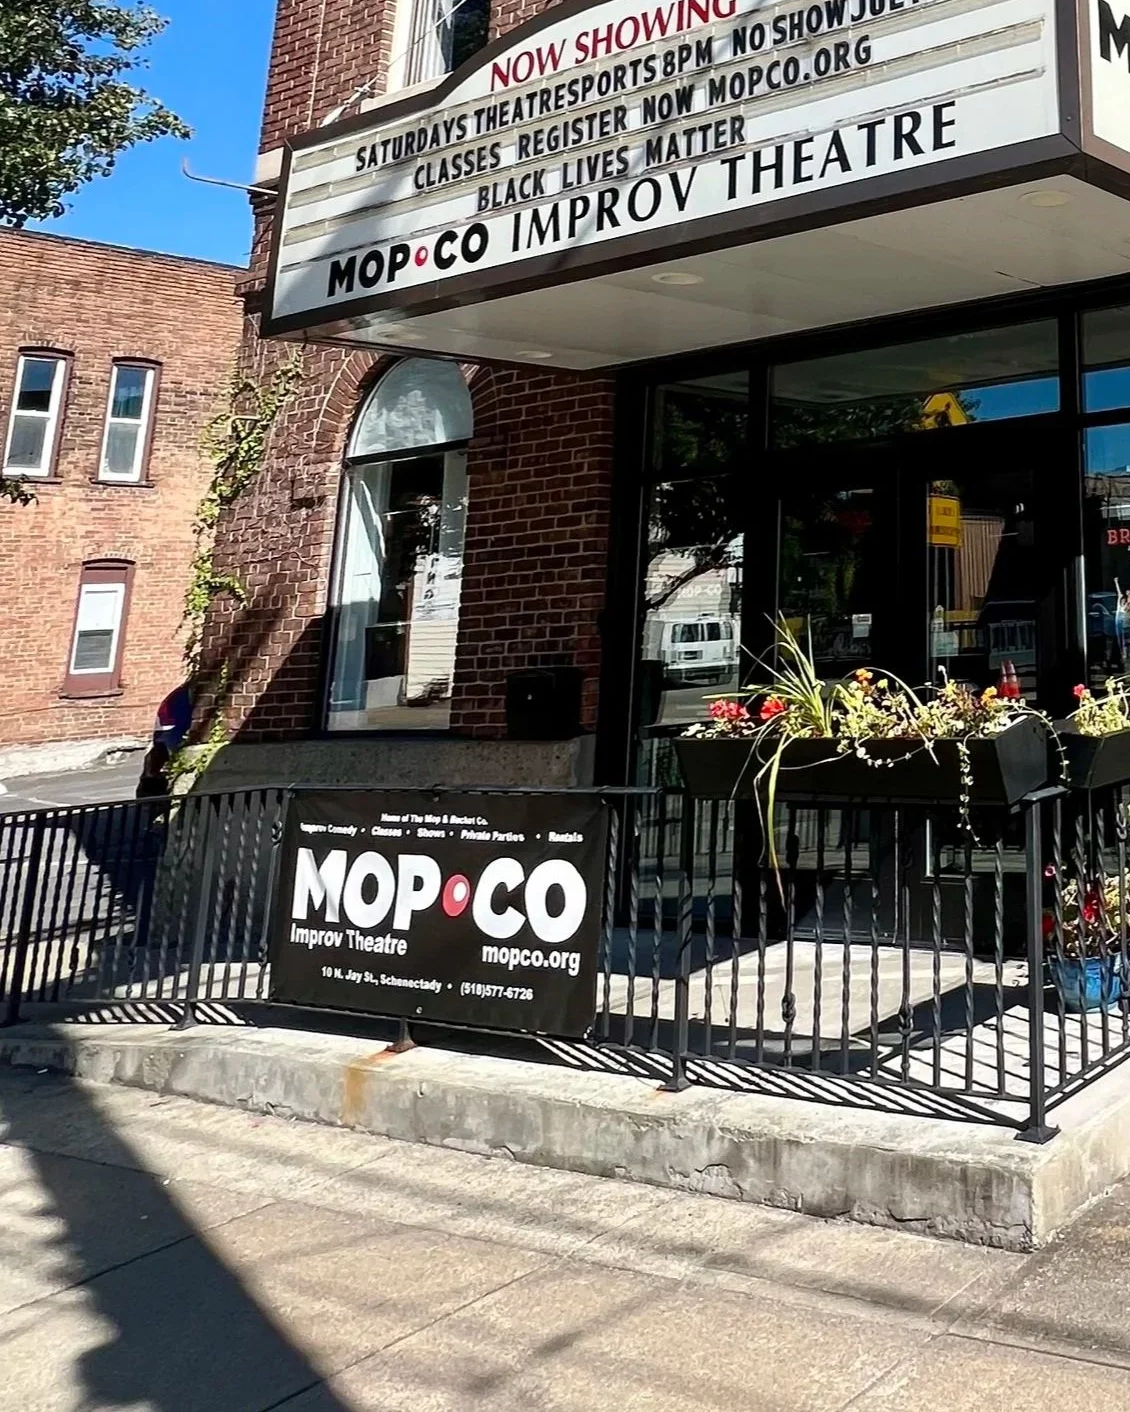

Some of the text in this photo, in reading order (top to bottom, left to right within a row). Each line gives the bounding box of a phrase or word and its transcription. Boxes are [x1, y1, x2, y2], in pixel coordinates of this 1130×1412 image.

[490, 38, 567, 92] NOW
[356, 113, 468, 172] SATURDAYS
[474, 53, 657, 135] THEATRESPORTS
[662, 35, 714, 77] 8PM
[732, 22, 765, 57] NO
[414, 34, 872, 190] CLASSES REGISTER NOW MOPCO.ORG
[477, 114, 745, 212] BLACK LIVES MATTER
[511, 166, 698, 253] IMPROV
[720, 100, 956, 201] THEATRE
[328, 824, 359, 837] Comedy
[371, 825, 402, 837] Classes
[417, 827, 446, 838] Shows
[460, 829, 491, 841] Private
[492, 831, 526, 842] Parties
[548, 831, 584, 842] Rentals
[411, 814, 424, 823] The
[290, 922, 408, 956] Improv Theatre
[482, 944, 581, 977] mopco.org
[321, 966, 332, 978] 10
[333, 968, 344, 980] N.
[345, 969, 363, 984] Jay
[380, 973, 443, 994] Schenectady
